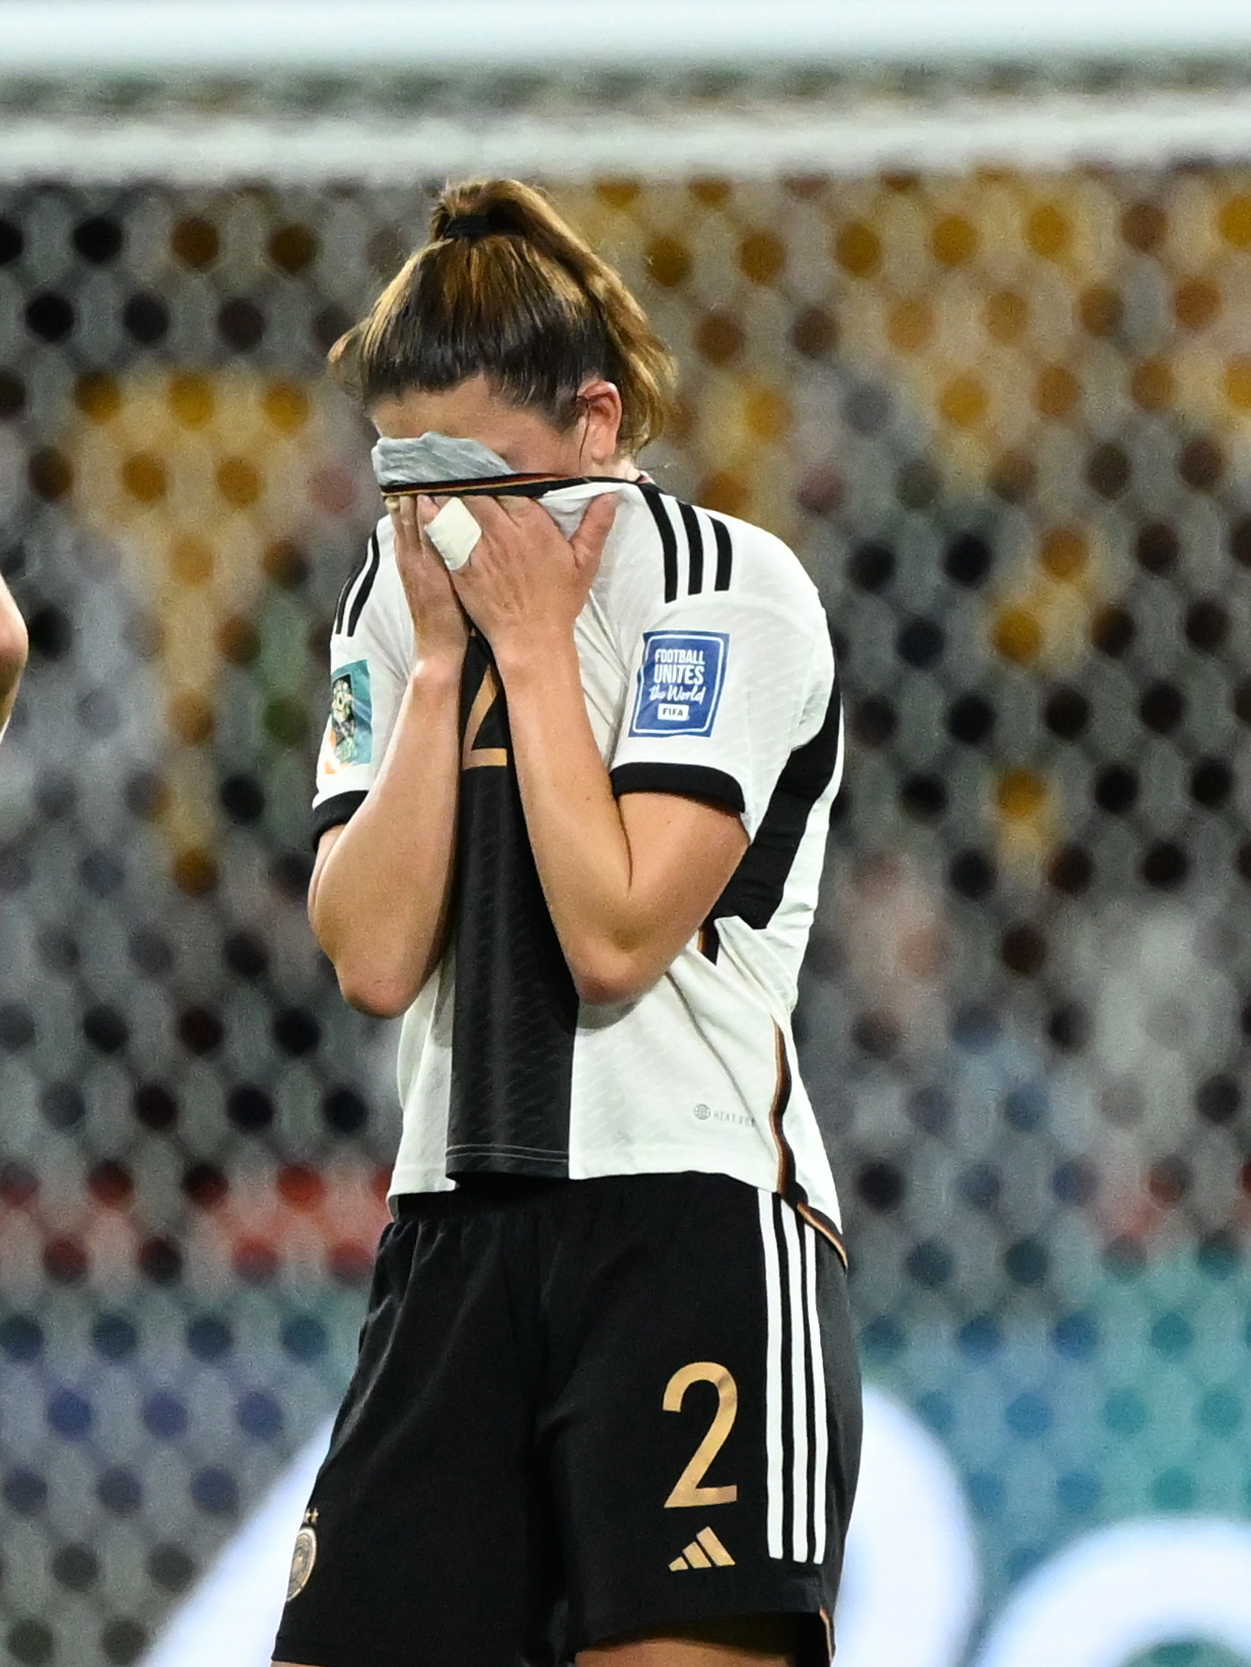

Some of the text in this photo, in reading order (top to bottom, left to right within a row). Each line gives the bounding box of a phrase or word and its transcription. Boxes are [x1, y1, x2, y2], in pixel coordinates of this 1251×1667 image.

[655, 648, 706, 665] FOOTBALL
[653, 663, 705, 685] UNITES
[649, 684, 707, 705] the World
[662, 707, 684, 717] FIFA
[662, 1361, 738, 1508] 2
